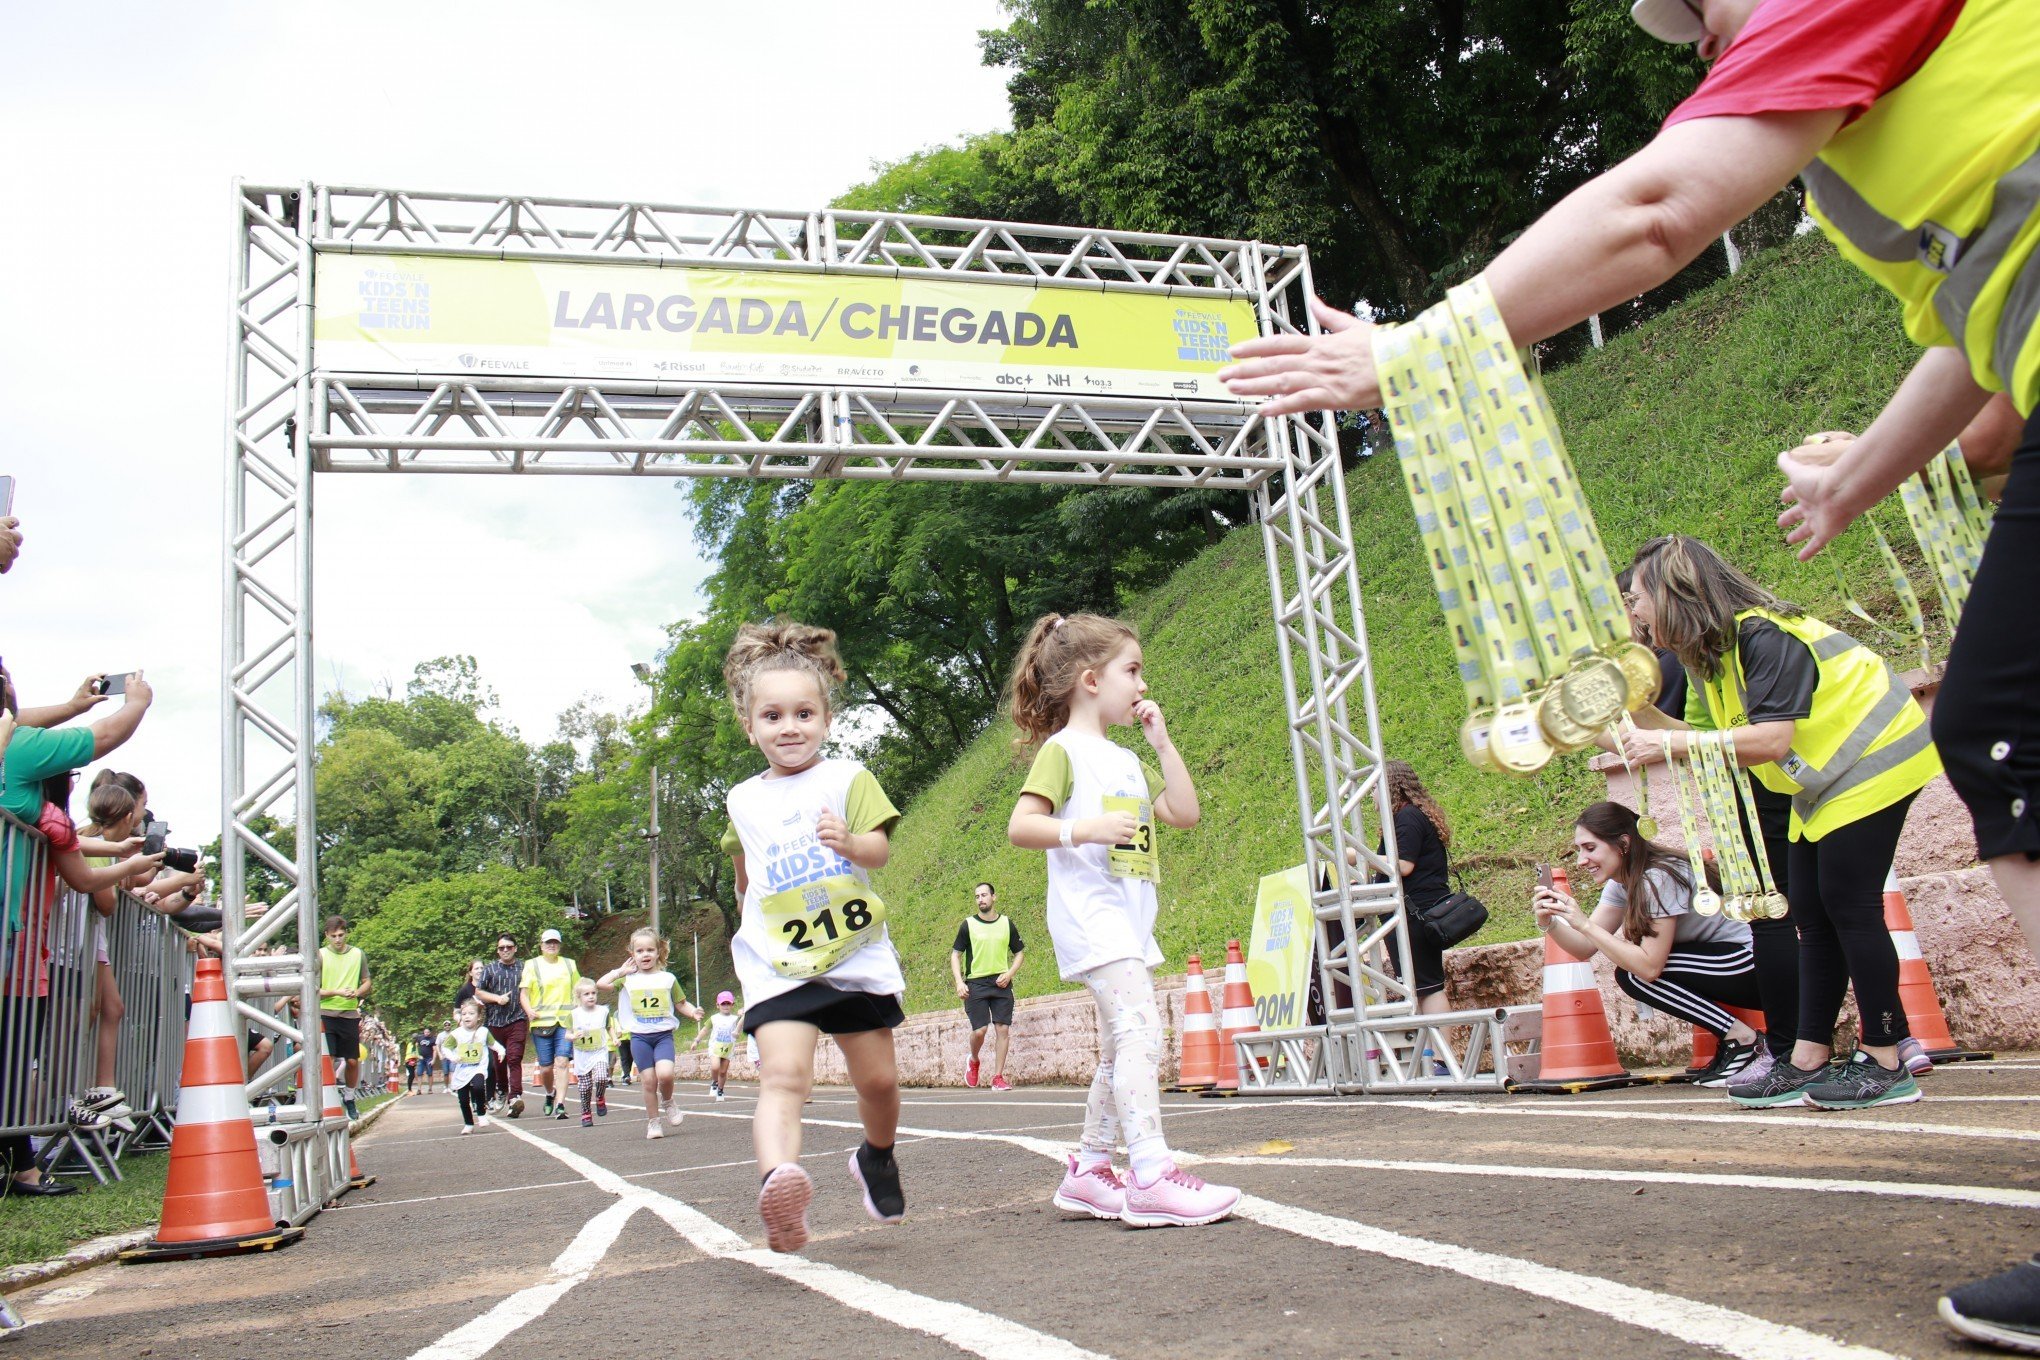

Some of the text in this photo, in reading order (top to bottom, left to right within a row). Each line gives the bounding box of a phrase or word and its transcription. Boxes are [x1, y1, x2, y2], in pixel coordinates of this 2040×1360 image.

[358, 281, 407, 297] KIDS
[363, 297, 430, 313] TEENS
[387, 314, 430, 329] RUN
[1172, 319, 1210, 333] KIDS
[1179, 333, 1230, 348] TEENS
[1199, 347, 1233, 362] RUN
[480, 360, 529, 370] FEEVALE
[670, 362, 706, 371] Rissul
[837, 366, 884, 376] BRAVECTO
[1047, 373, 1071, 387] NH
[766, 845, 826, 887] KIDS
[783, 898, 872, 952] 218
[640, 997, 660, 1008] 12
[580, 1036, 594, 1045] 11
[464, 1049, 479, 1058] 13
